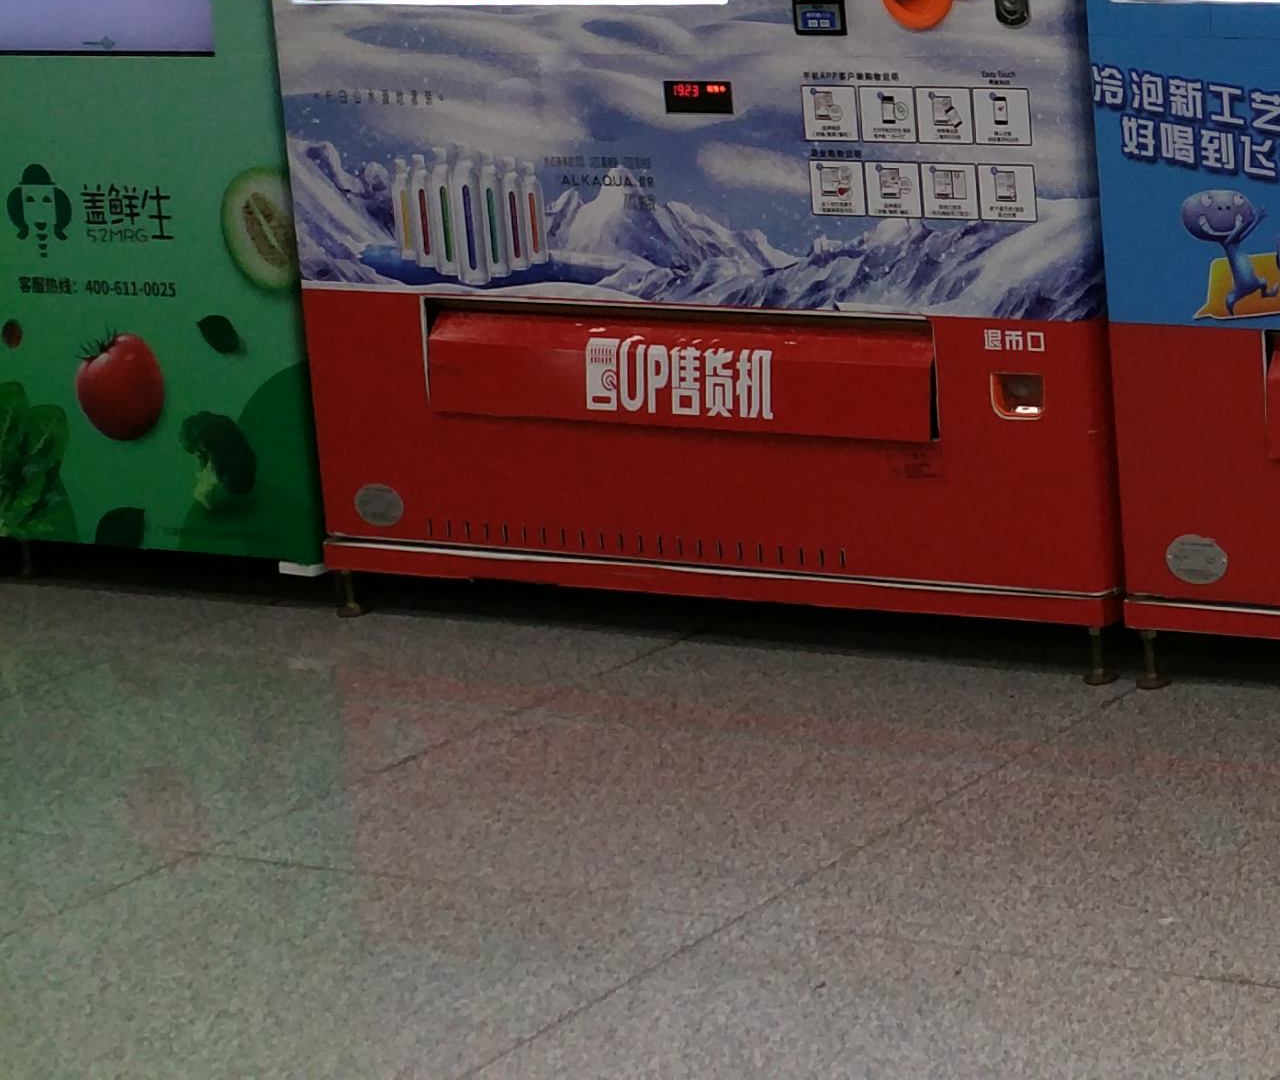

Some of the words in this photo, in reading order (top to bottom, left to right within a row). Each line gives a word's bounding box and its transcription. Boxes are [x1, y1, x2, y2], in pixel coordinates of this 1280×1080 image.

[672, 84, 700, 98] 1923
[560, 173, 634, 188] ALKAQUA
[80, 182, 175, 241] 盖鲜生
[85, 279, 177, 299] 400-611-0025
[983, 328, 1046, 352] 退币口
[619, 338, 774, 421] UP售货机
